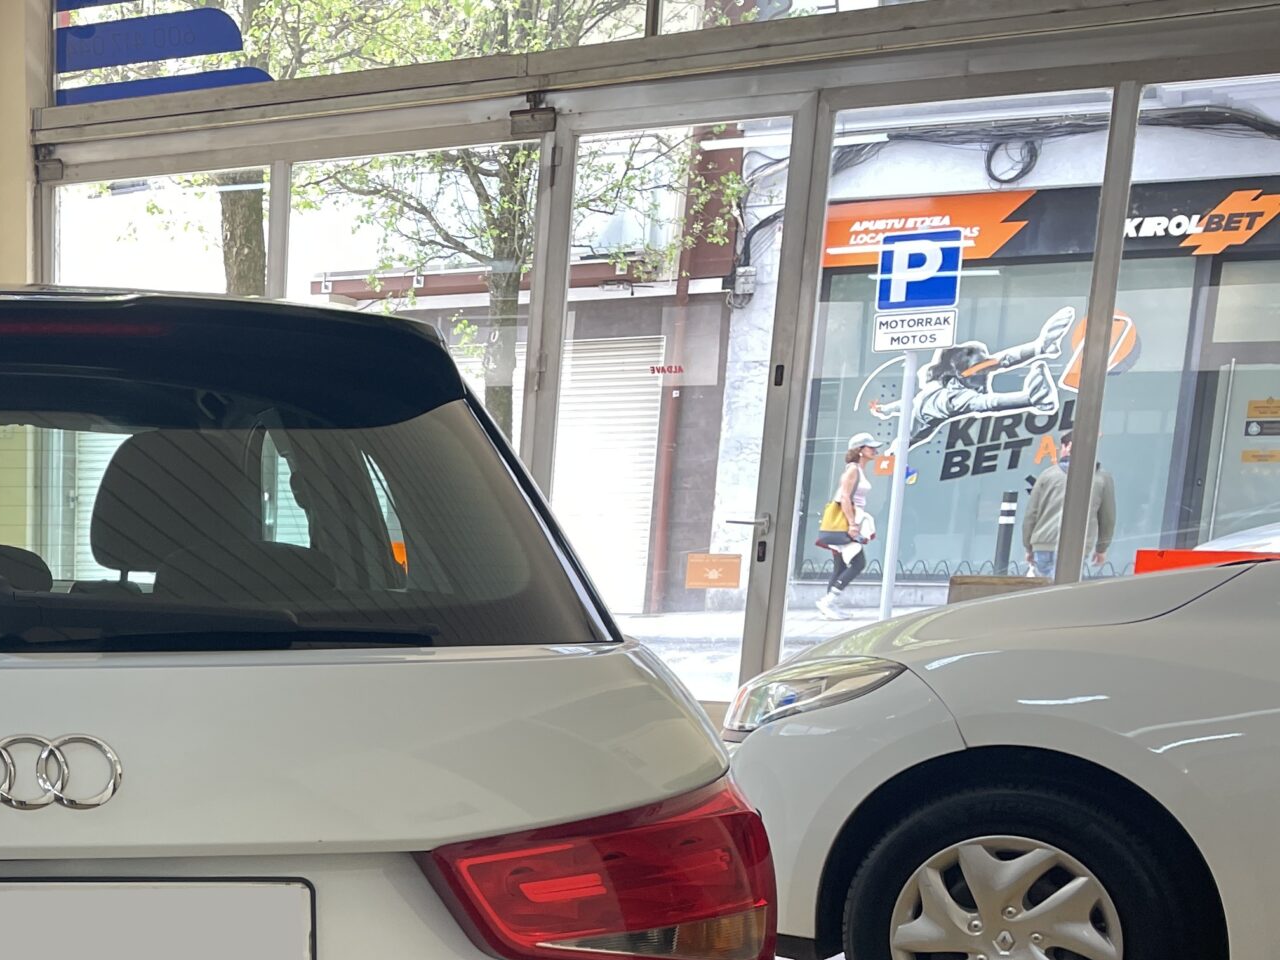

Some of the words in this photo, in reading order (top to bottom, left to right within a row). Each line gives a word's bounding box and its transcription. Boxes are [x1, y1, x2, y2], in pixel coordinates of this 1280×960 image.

[1123, 211, 1265, 238] KIROLBET
[889, 239, 943, 303] P
[878, 315, 951, 330] MOTORRAK
[890, 333, 937, 345] MOTOS
[939, 437, 1034, 481] BET
